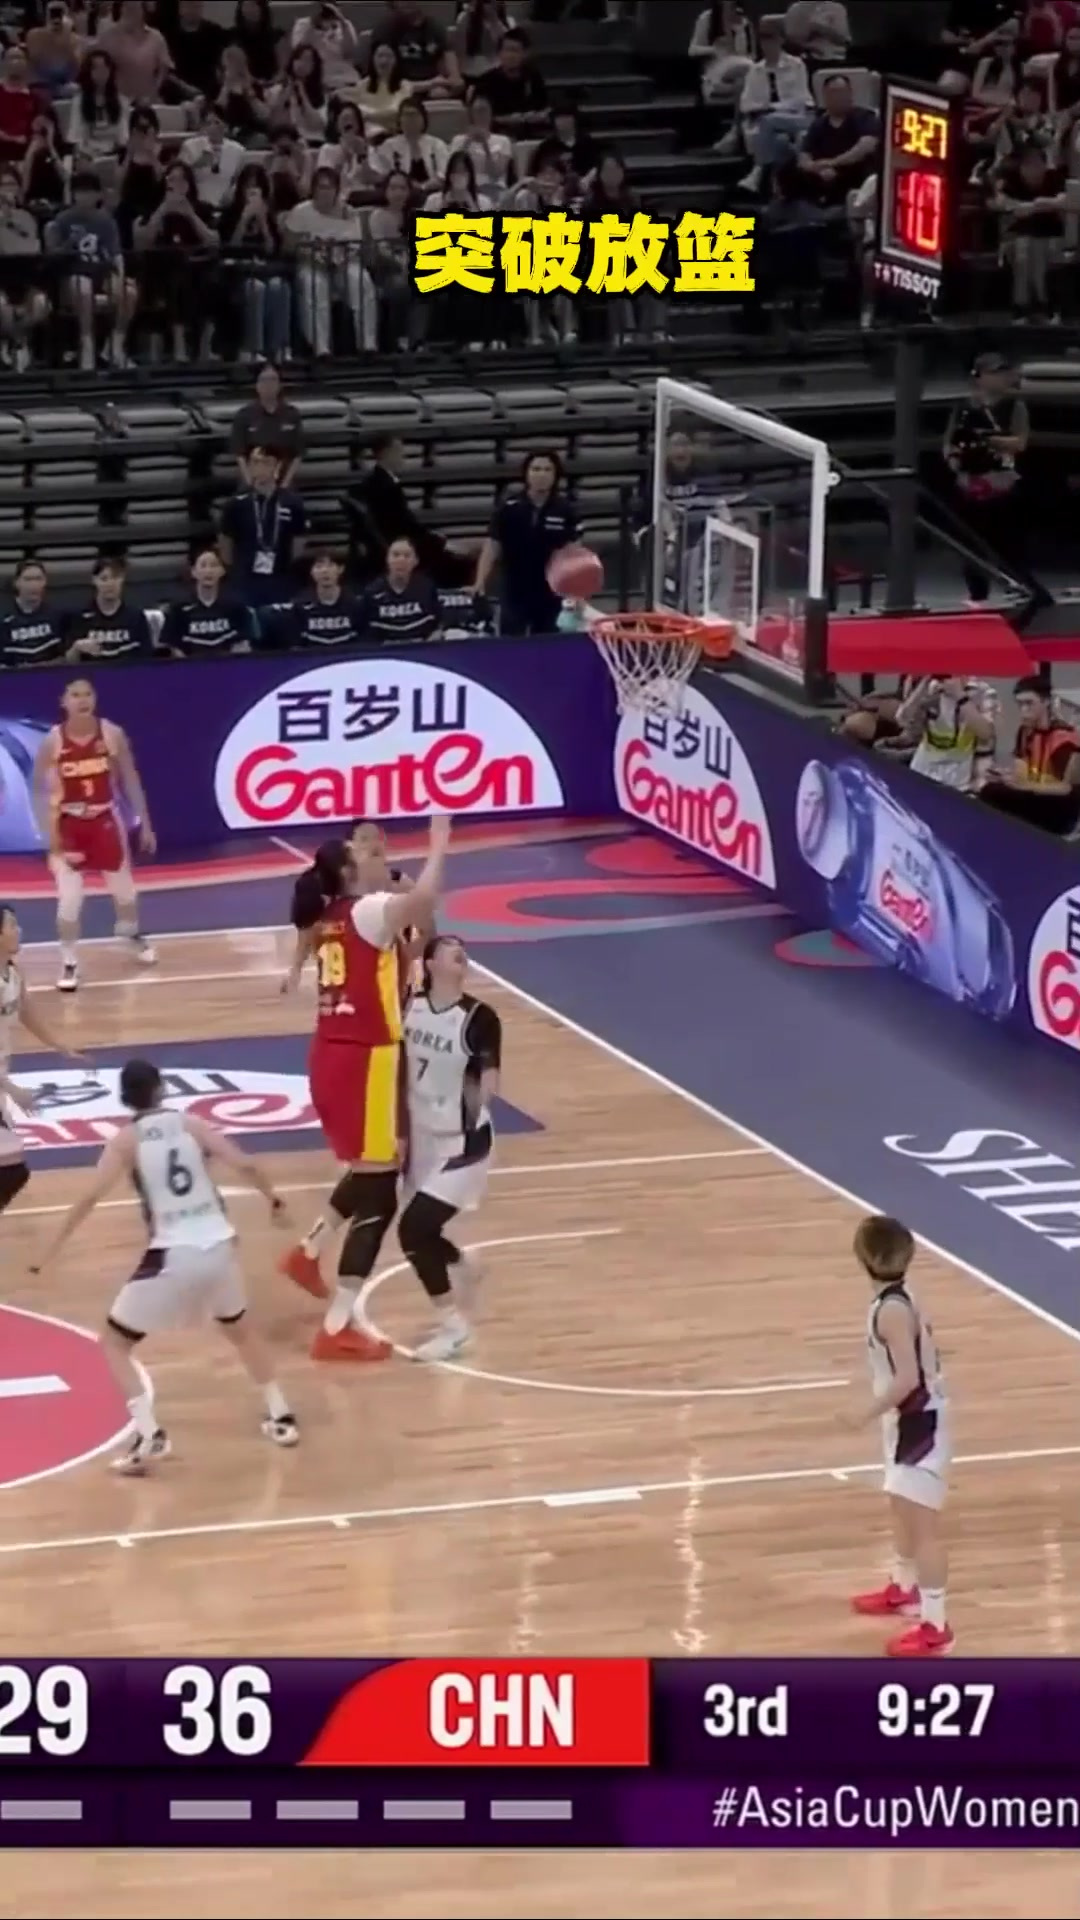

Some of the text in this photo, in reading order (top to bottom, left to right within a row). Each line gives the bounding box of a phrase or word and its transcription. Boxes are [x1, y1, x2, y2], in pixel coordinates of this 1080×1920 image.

[891, 265, 941, 299] TISSOT
[189, 618, 230, 634] KOREA
[308, 616, 350, 631] KOREA
[378, 602, 422, 618] KOREA
[277, 683, 467, 743] 百岁山
[235, 733, 534, 822] Ganten
[623, 738, 762, 878] Ganten
[404, 1025, 453, 1054] KOREA
[417, 1057, 429, 1082] 7
[168, 1147, 193, 1197] 6
[882, 1128, 1080, 1252] SHE
